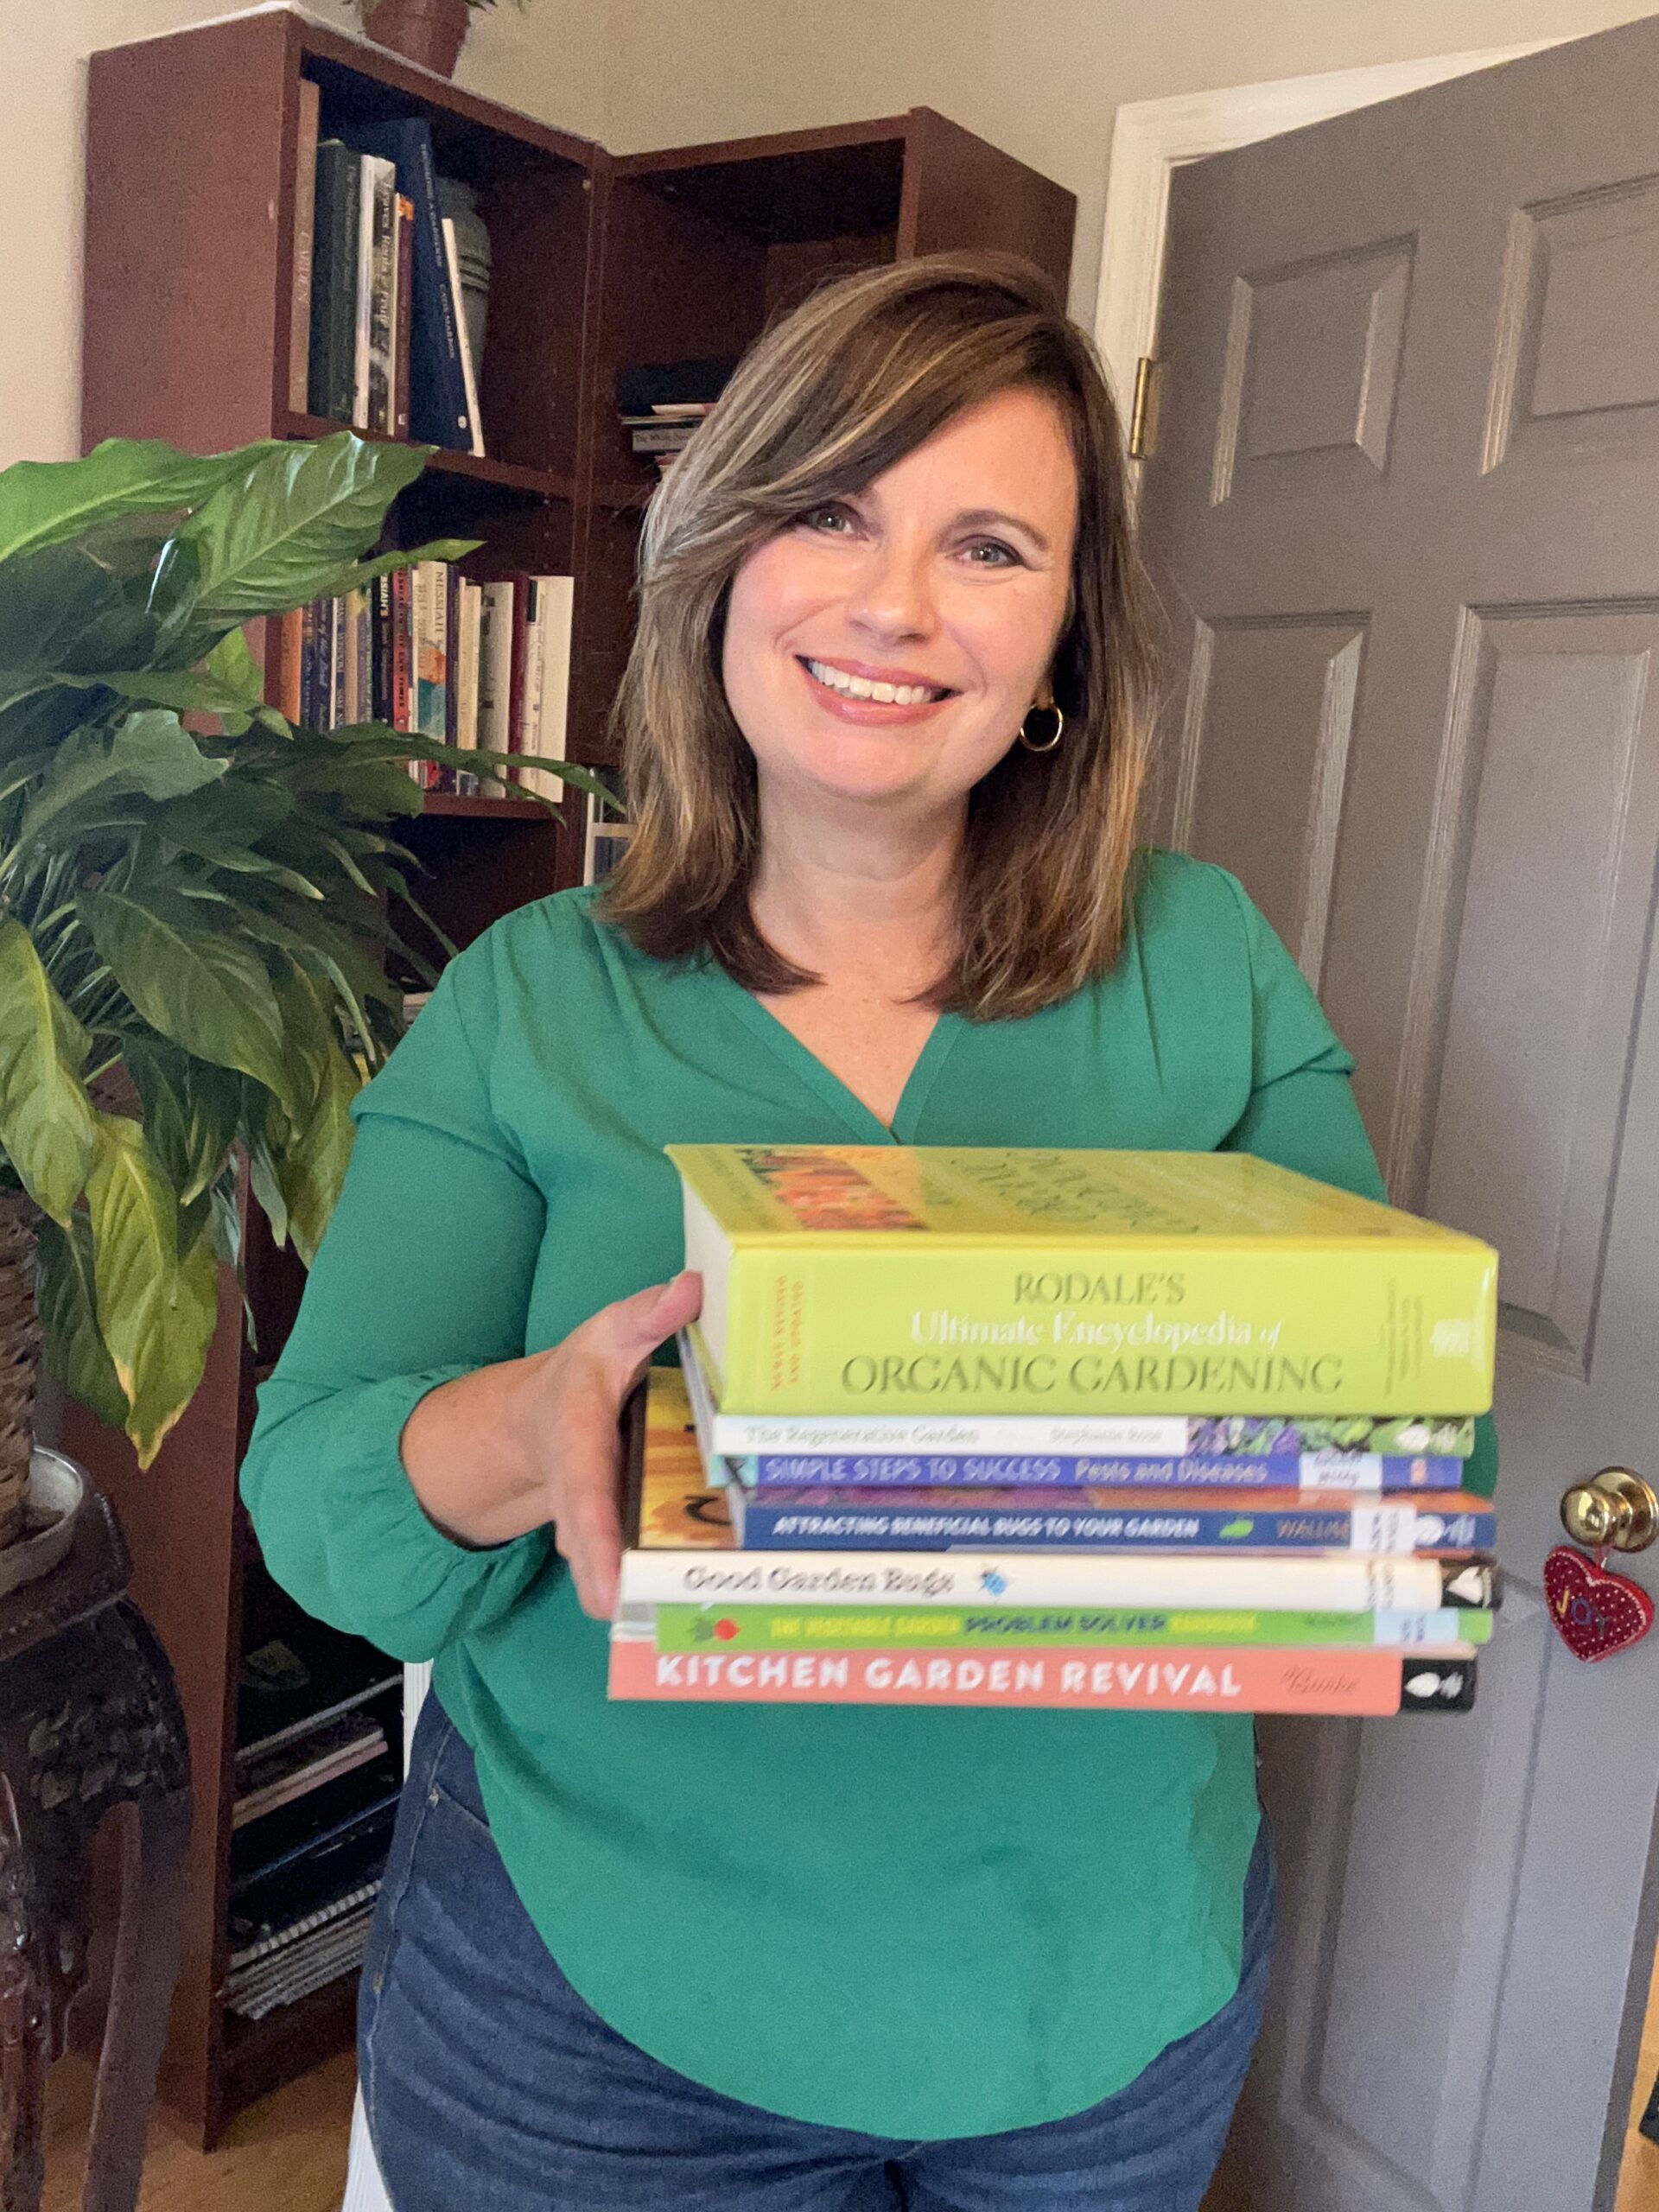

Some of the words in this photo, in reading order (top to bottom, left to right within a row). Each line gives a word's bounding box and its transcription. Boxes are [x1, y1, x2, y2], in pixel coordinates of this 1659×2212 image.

[435, 572, 444, 632] MESSIAH
[1014, 1273, 1185, 1304] RODALE'S
[912, 1310, 1042, 1345] Ultimate
[1052, 1310, 1251, 1354] Encyclopedia
[842, 1354, 1056, 1395] ORGANIC
[1068, 1354, 1344, 1395] GARDENING
[766, 1457, 849, 1482] SIMPLE
[852, 1457, 922, 1482] STEPS
[925, 1457, 958, 1481] TO
[962, 1457, 1062, 1482] SUCCESS
[1074, 1458, 1131, 1481] Pests
[1133, 1458, 1173, 1481] and
[1176, 1457, 1268, 1482] Diseases
[772, 1516, 890, 1536] ATTRACTING
[889, 1516, 992, 1537] BENEFICIAL
[993, 1516, 1042, 1537] BUGS
[1044, 1517, 1071, 1537] TO
[1072, 1517, 1124, 1537] YOUR
[1124, 1517, 1199, 1538] GARDEN
[683, 1566, 764, 1592] Good
[768, 1567, 877, 1592] Garden
[881, 1567, 956, 1599] Bugs
[655, 1655, 849, 1688] KITCHEN
[865, 1657, 1045, 1693] GARDEN
[1060, 1660, 1242, 1698] REVIVAL
